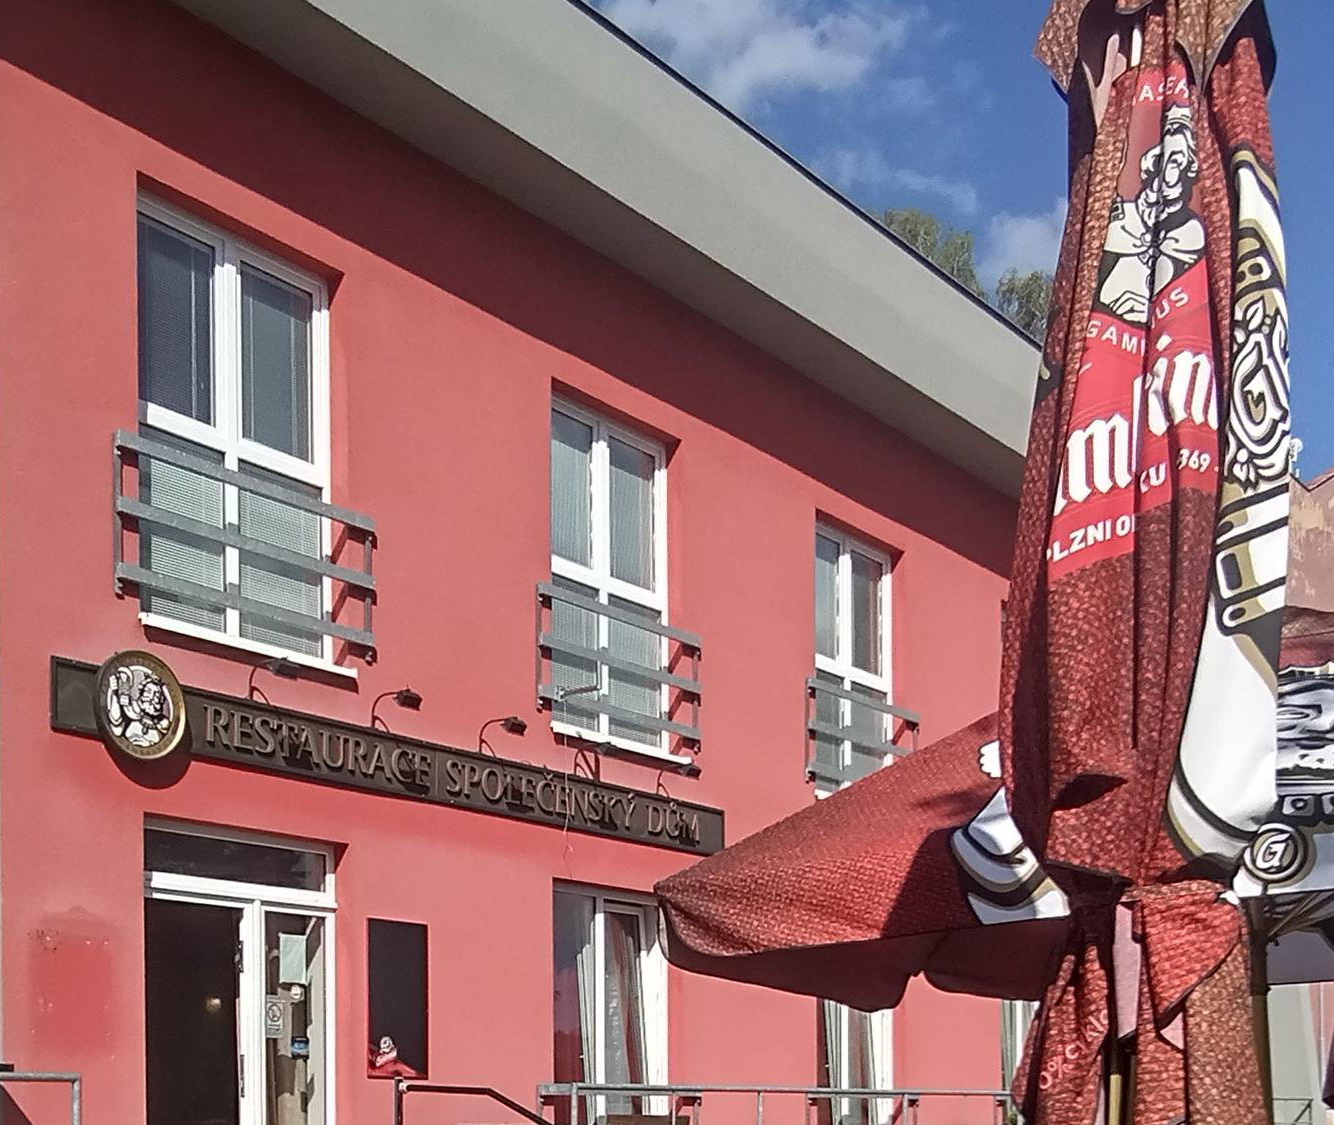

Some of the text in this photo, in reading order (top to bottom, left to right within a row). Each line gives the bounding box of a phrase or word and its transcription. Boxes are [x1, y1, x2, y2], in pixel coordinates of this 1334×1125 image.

[1046, 516, 1111, 562] LZNI
[203, 704, 701, 846] RESTAURACE SPOLEČENSKÝ DŮM
